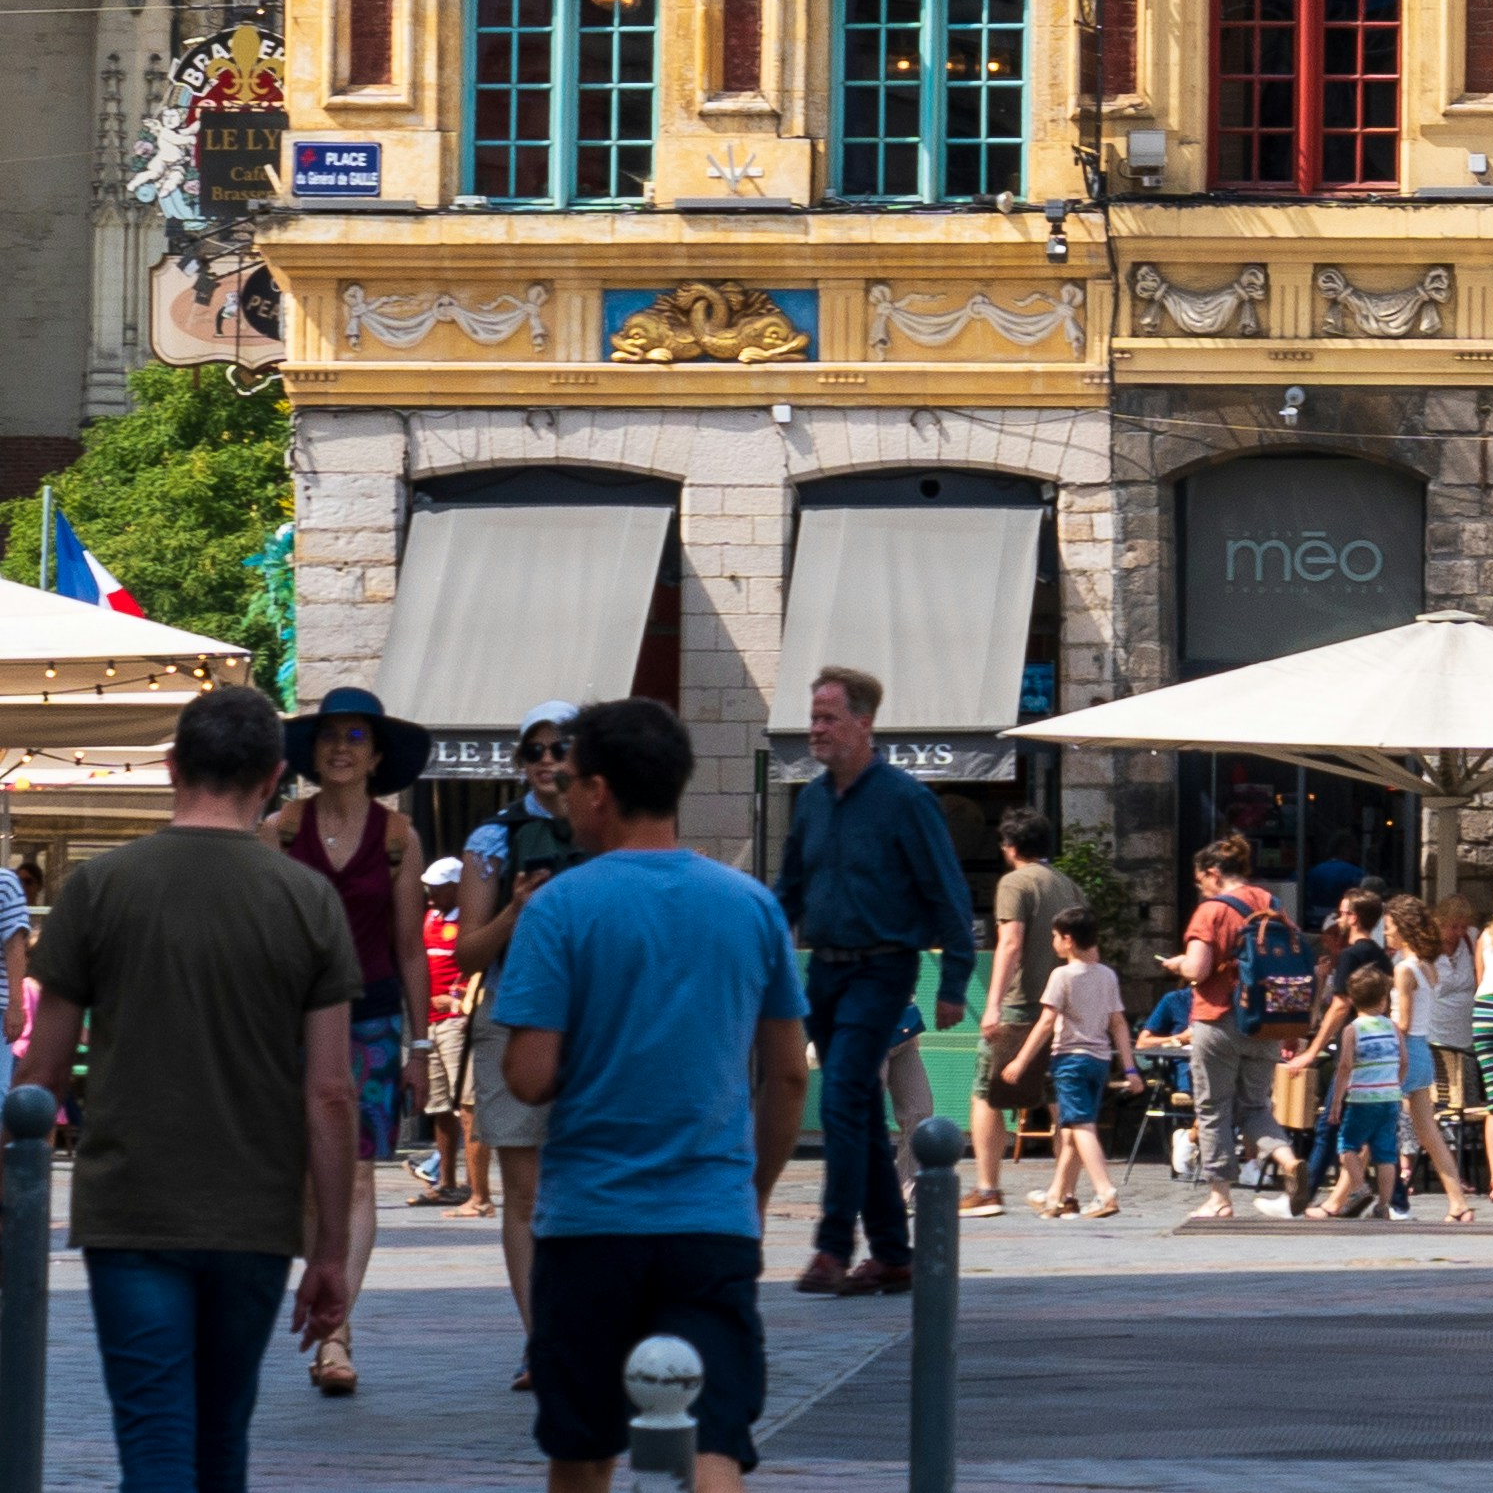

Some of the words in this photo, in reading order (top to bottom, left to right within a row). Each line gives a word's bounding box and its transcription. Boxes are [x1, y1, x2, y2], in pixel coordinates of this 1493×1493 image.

[205, 129, 239, 151] LE
[248, 129, 281, 151] LY
[325, 152, 368, 167] PLACE
[437, 741, 481, 763] LE
[888, 744, 954, 765] LYS
